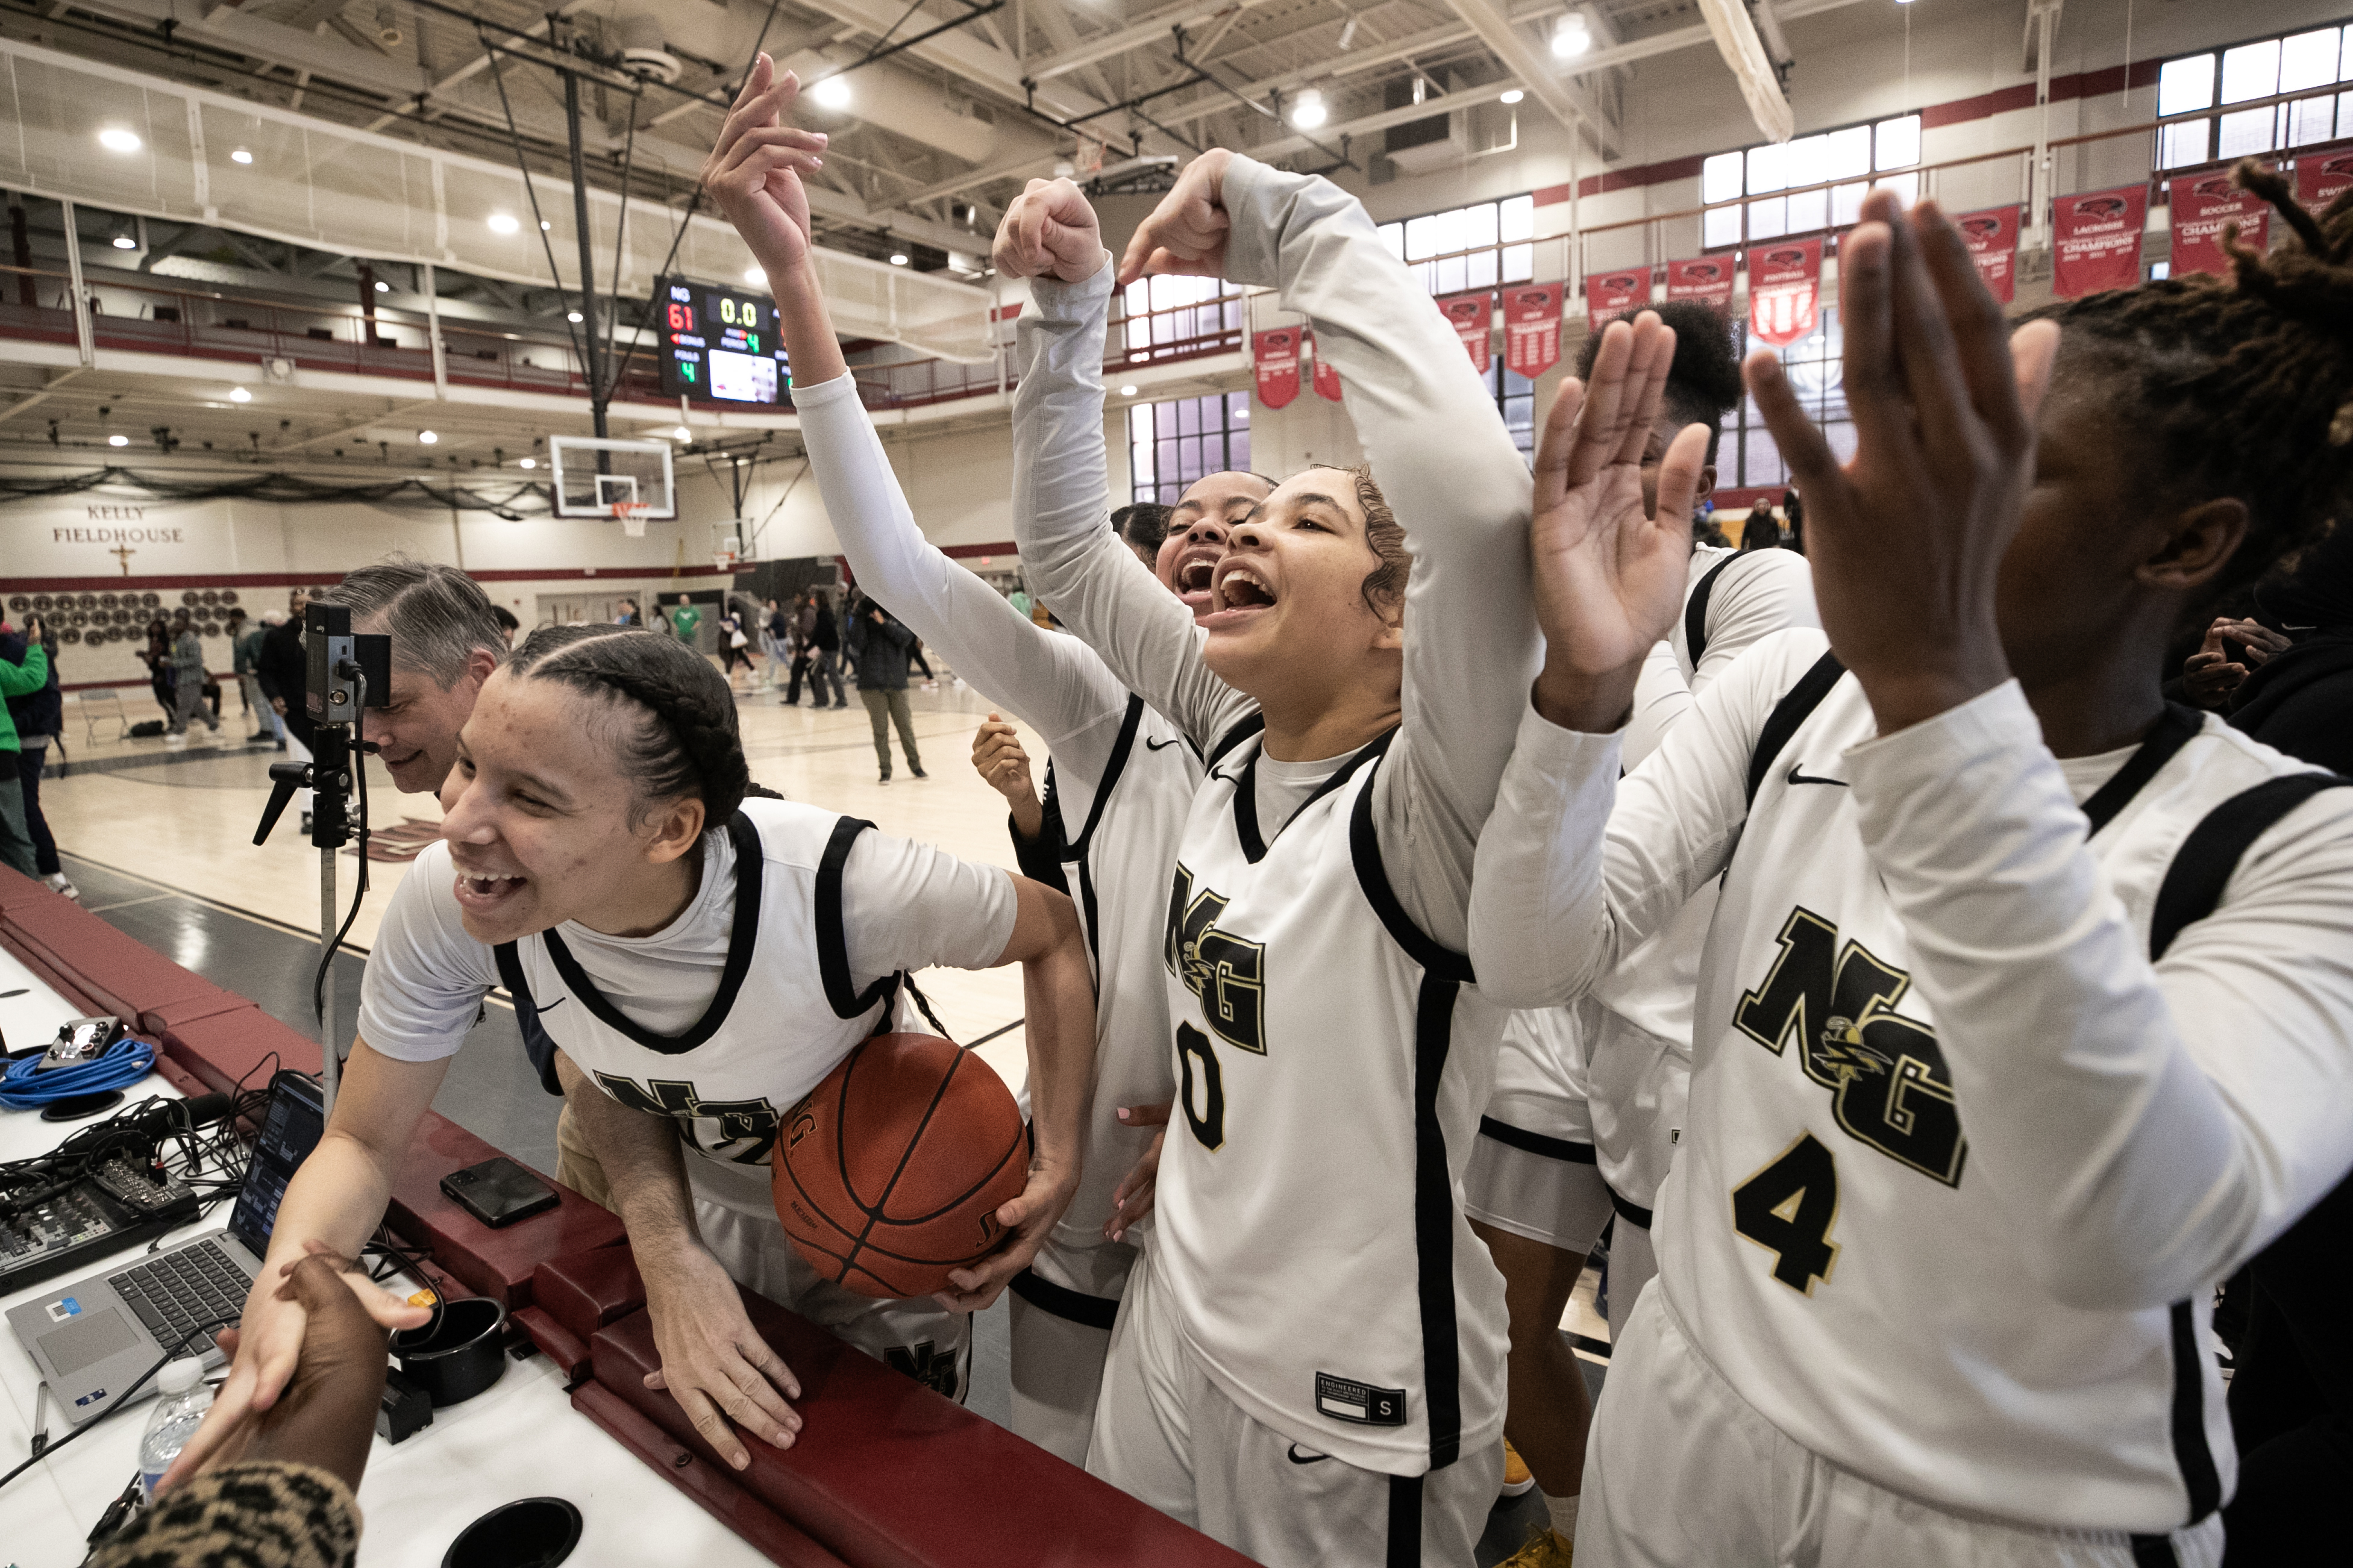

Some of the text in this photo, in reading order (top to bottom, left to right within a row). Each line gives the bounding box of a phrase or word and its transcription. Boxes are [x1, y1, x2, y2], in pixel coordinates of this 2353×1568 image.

[2199, 201, 2242, 217] SOCCER
[671, 286, 691, 302] NG
[668, 304, 692, 331] 61
[720, 298, 757, 327] 0.0
[747, 333, 759, 353] 4
[681, 362, 695, 383] 4
[87, 505, 143, 519] KELLY
[53, 527, 183, 543] FIELDHOUSE
[1732, 905, 1969, 1190] NG
[1176, 1018, 1227, 1154] 0
[1730, 1129, 1842, 1299] 4
[1321, 1379, 1366, 1395] ENGINEERED
[1380, 1401, 1391, 1415] S
